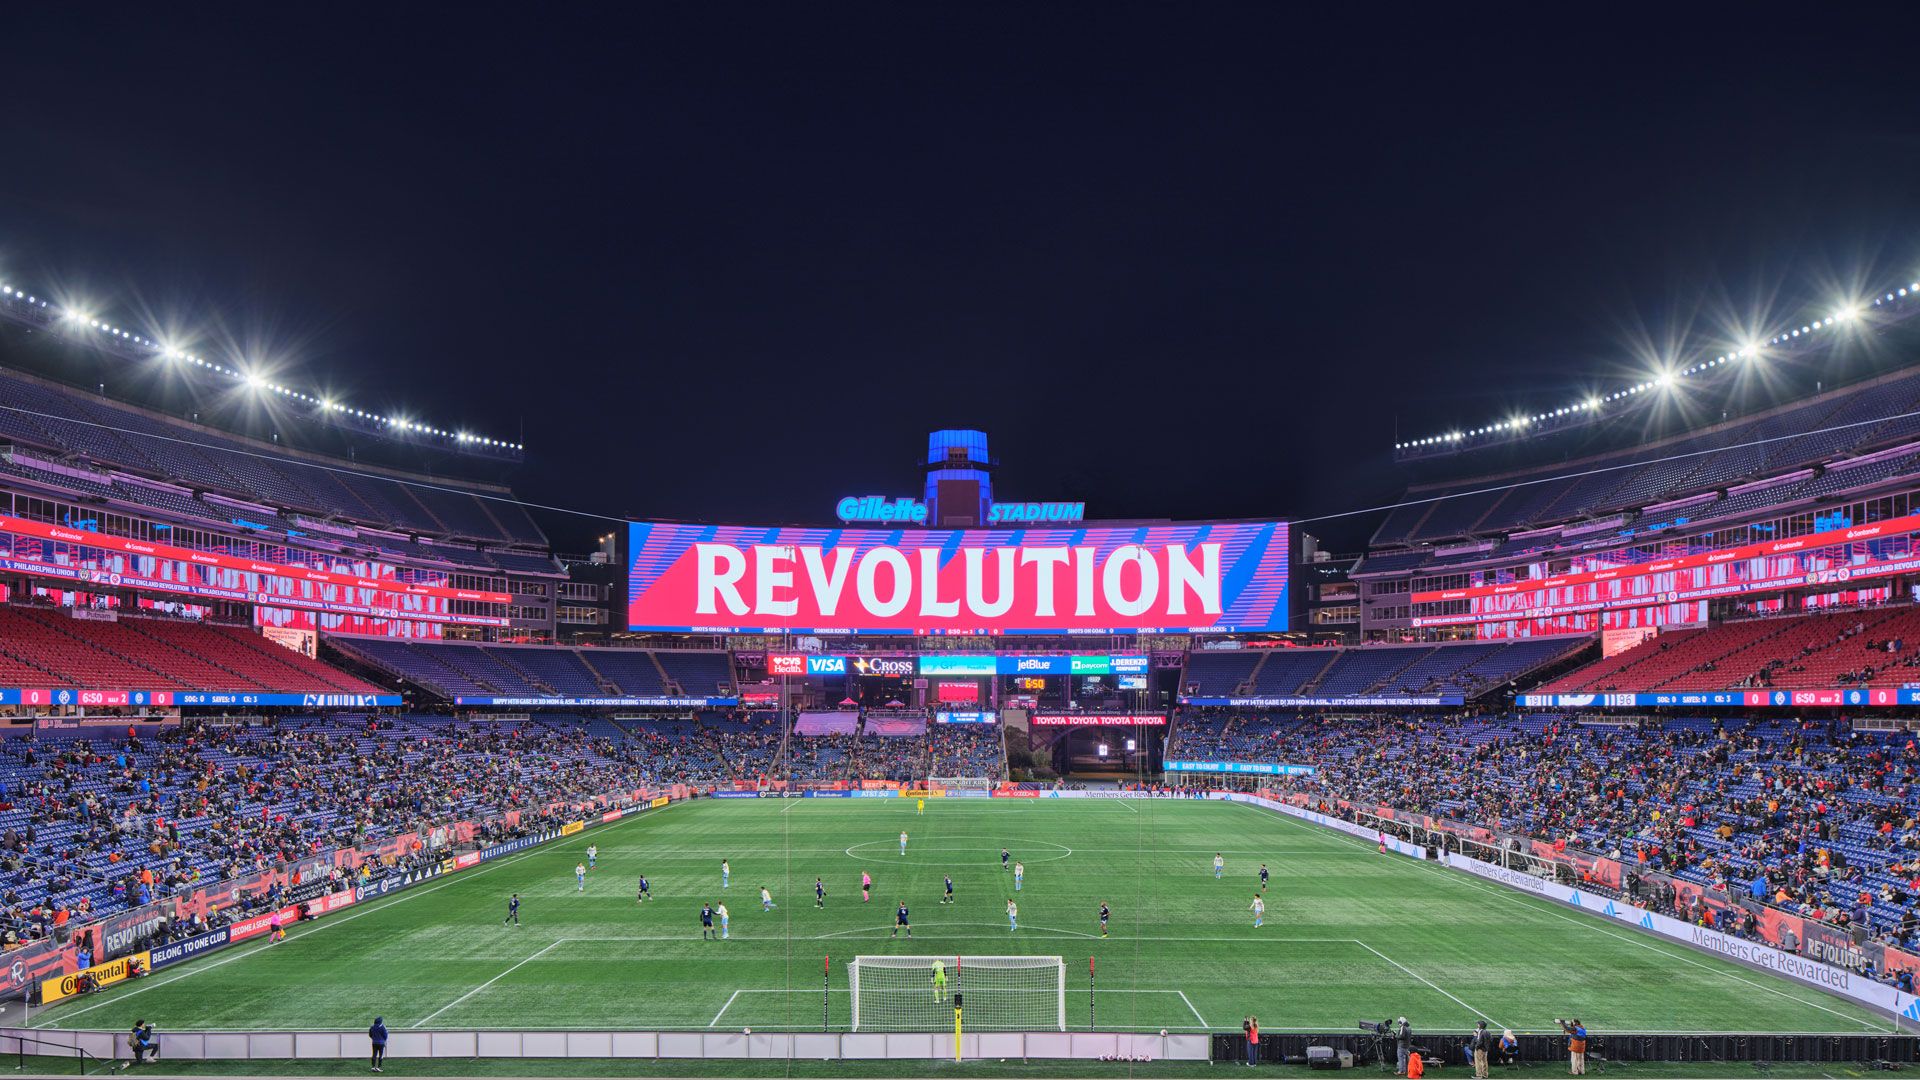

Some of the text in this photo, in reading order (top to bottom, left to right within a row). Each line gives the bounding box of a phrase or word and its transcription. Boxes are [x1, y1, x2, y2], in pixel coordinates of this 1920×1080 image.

[838, 497, 1085, 521] Gillette STADIUM
[57, 532, 83, 541] Santander
[1852, 527, 1880, 537] Santander
[131, 544, 154, 553] Santander
[1779, 541, 1804, 550] Santander
[197, 555, 218, 563] Santander
[1713, 552, 1736, 560] Santander
[13, 563, 75, 577] PHILADELPHIA UNION
[1852, 568, 1866, 576] NEW
[1866, 564, 1894, 574] ENGLAND
[135, 579, 158, 588] ENGLAND
[158, 582, 190, 592] REVOLUTION
[694, 543, 1223, 619] REVOLUTION
[1750, 577, 1803, 590] PHILADELPHIA UNION
[198, 588, 230, 596] PHILADELPHIA
[1710, 586, 1741, 596] REVOLUTION
[782, 658, 801, 666] CVS
[808, 658, 845, 672] VISA
[870, 658, 912, 672] CROSS
[1018, 660, 1050, 672] jetBlue
[1026, 679, 1044, 688] 6:50
[31, 692, 38, 703] 0
[82, 692, 126, 704] 6:50 2
[158, 694, 164, 704] 0
[1529, 695, 1631, 706] 19 96
[1752, 694, 1758, 704] 0
[1796, 693, 1840, 703] 6:50 2
[1879, 694, 1886, 703] 0
[1036, 716, 1066, 724] TOYOTA
[1068, 716, 1098, 724] TOYOTA
[1100, 716, 1130, 724] TOYOTA
[1132, 716, 1162, 724] TOYOTA
[480, 842, 518, 860] PRESIDENTS
[520, 836, 538, 847] CLUB
[1470, 860, 1545, 892] Members Get Rewarded
[230, 924, 252, 936] BECOME
[256, 918, 272, 928] SEASO
[152, 931, 227, 964] BELONG TO ONE CLUB
[1692, 927, 1850, 990] Members Get Rewarded
